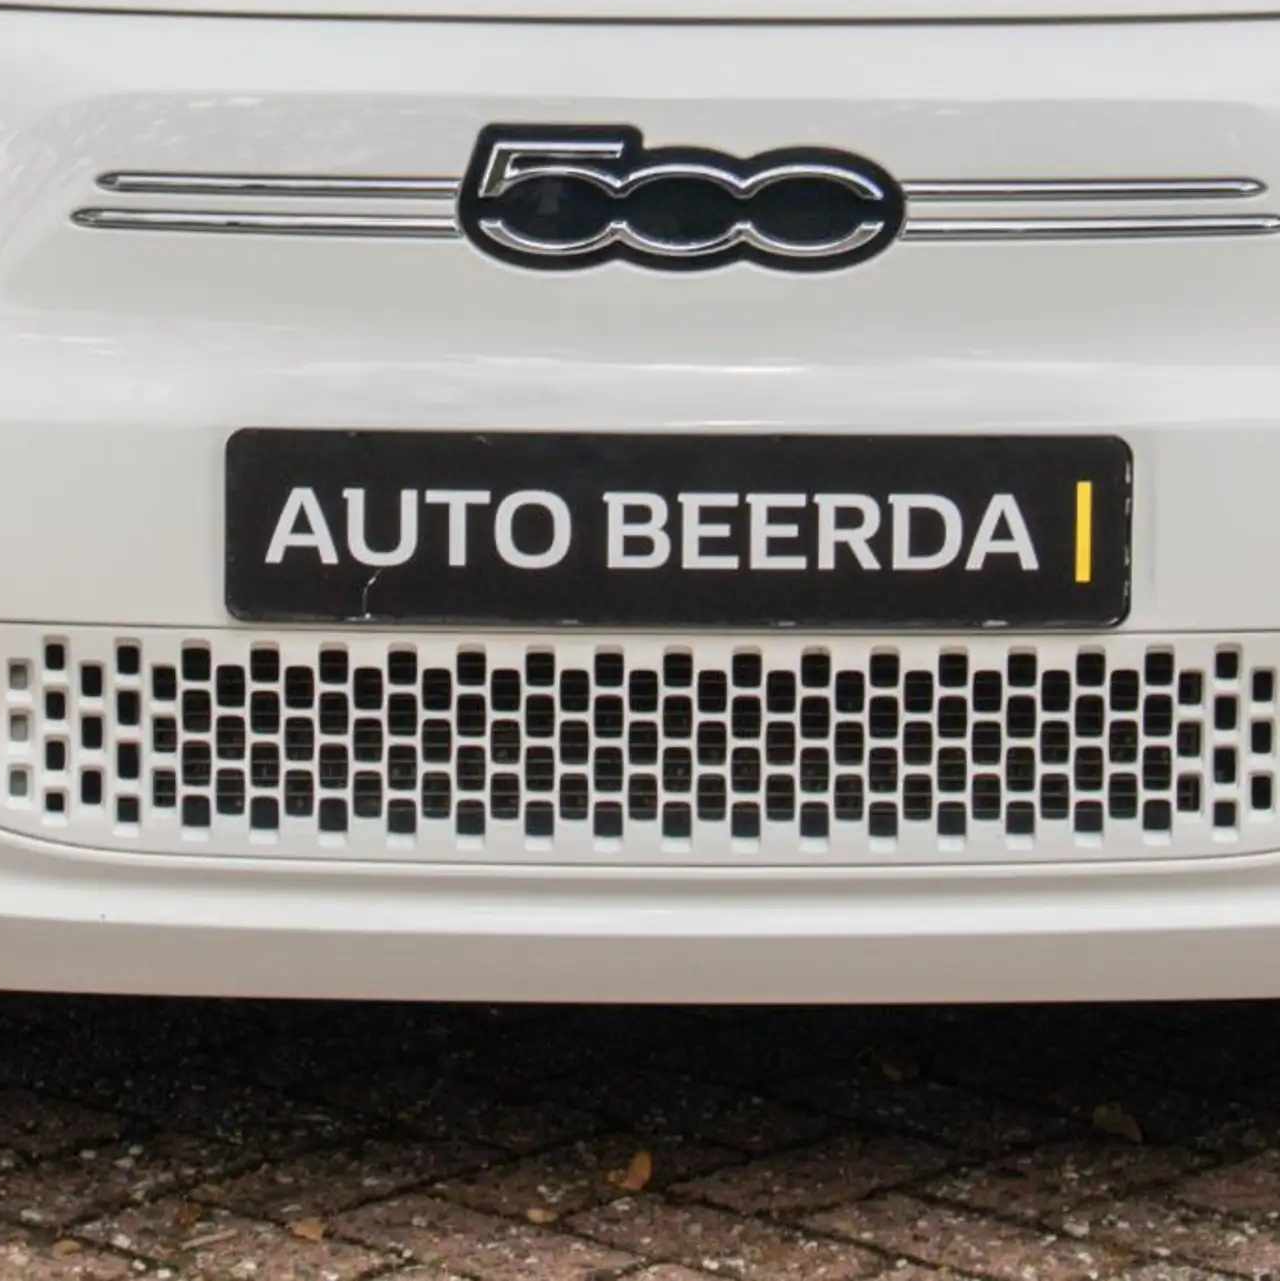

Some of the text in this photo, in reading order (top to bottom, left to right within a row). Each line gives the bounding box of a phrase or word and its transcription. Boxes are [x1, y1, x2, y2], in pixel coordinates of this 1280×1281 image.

[478, 141, 885, 258] 500
[264, 487, 1039, 571] AUTO BEERDA
